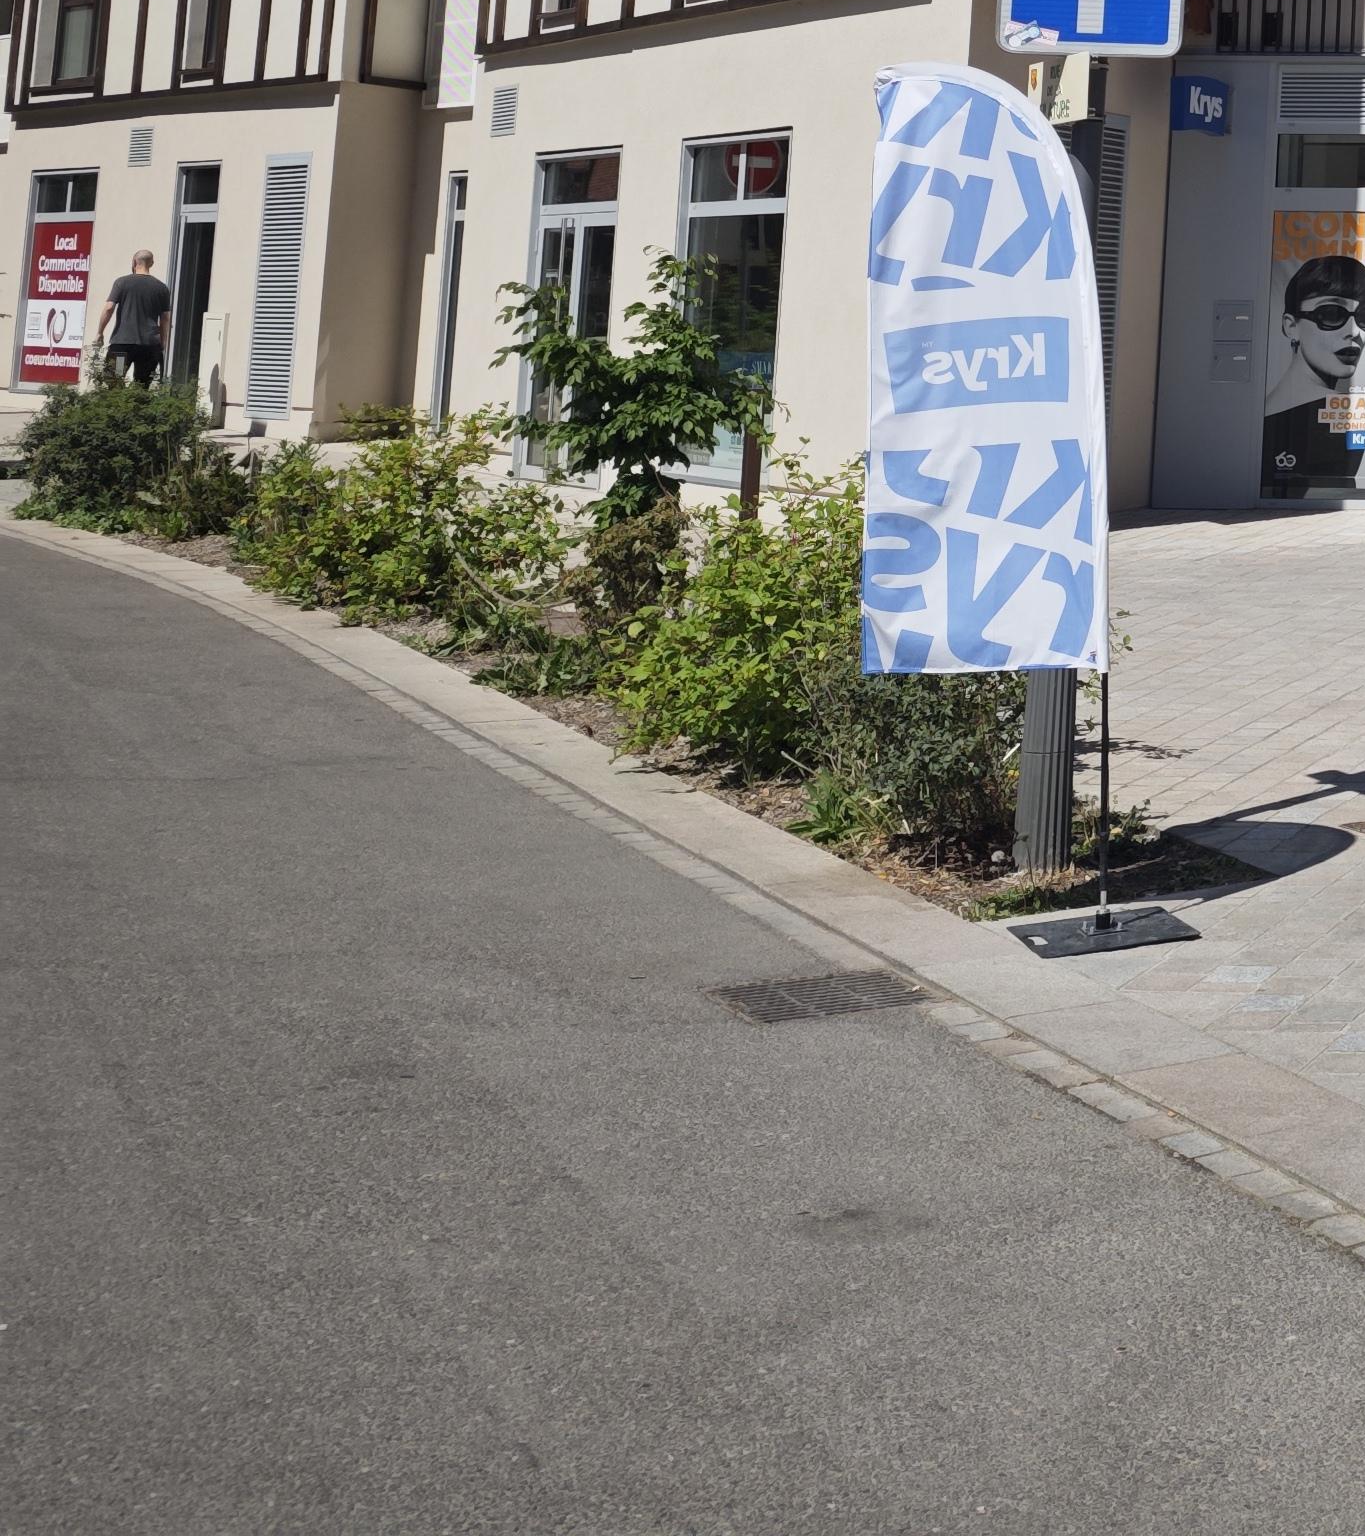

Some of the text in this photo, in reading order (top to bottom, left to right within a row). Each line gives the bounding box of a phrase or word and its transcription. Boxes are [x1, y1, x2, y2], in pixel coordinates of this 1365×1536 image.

[1190, 85, 1223, 123] Krys
[54, 233, 78, 251] Local
[38, 253, 91, 272] Commercial
[37, 275, 84, 295] Disponible
[1329, 396, 1351, 410] 60
[1321, 411, 1336, 420] DE
